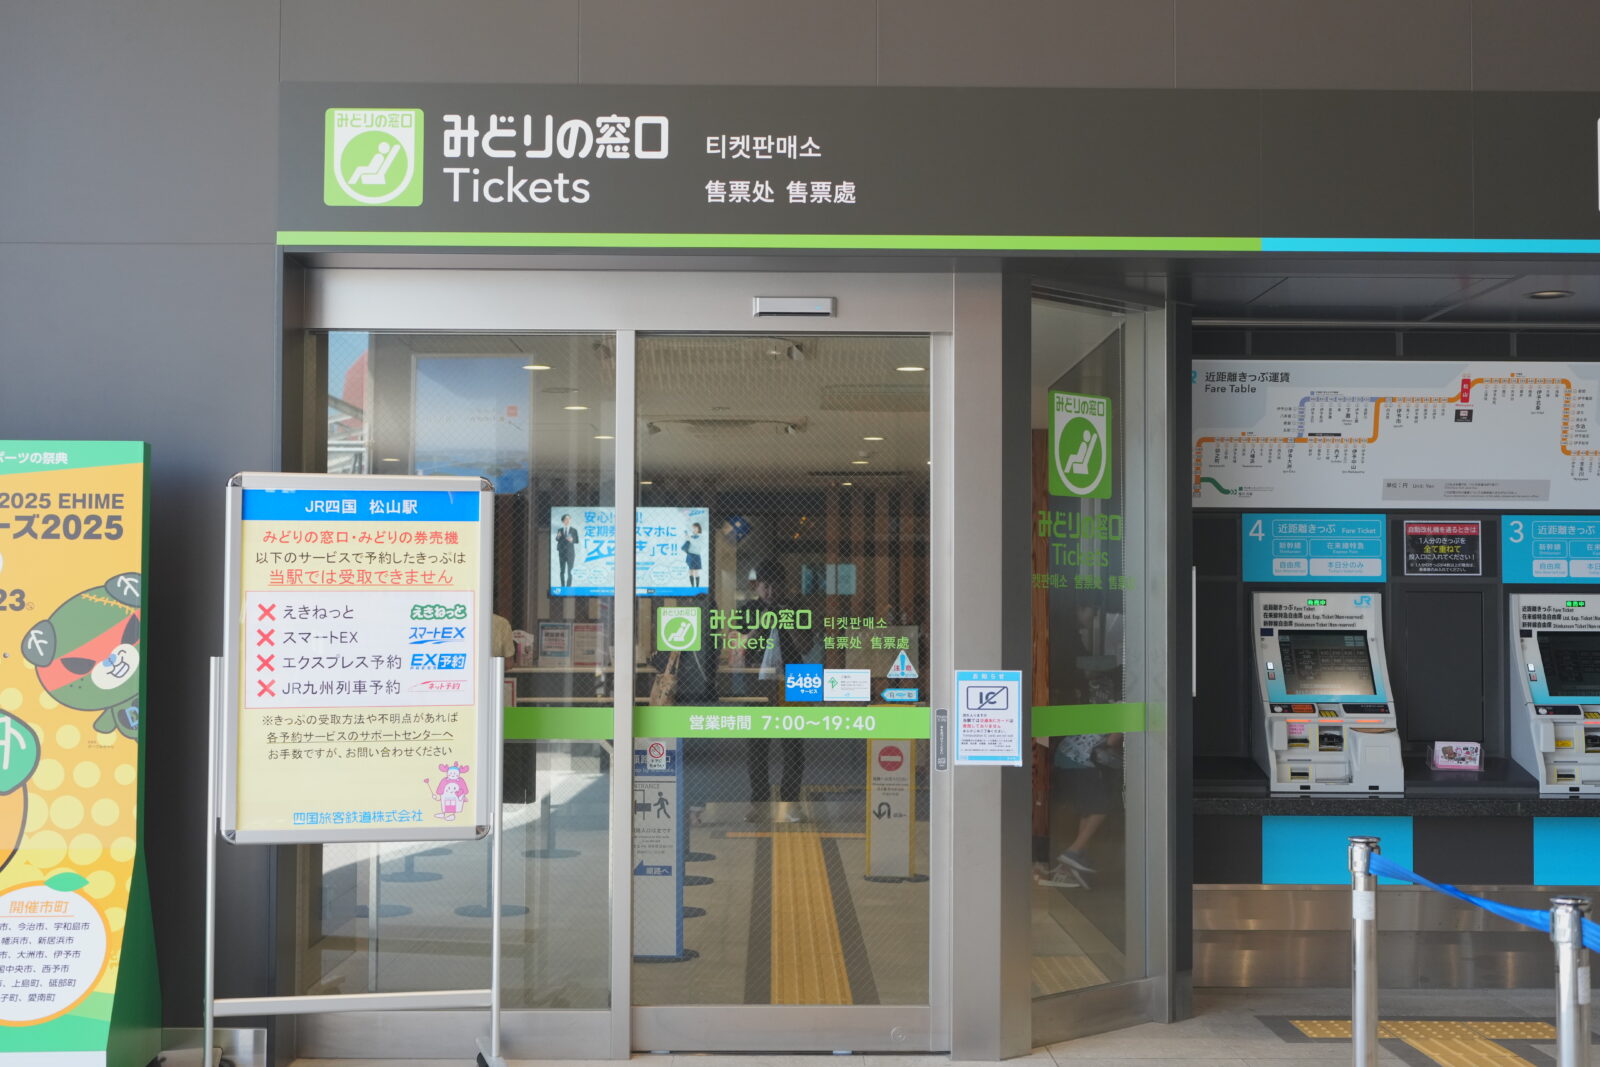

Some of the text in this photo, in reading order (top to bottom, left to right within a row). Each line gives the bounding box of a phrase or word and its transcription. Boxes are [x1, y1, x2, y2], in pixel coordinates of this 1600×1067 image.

[335, 112, 413, 129] みどりの窓口
[443, 114, 669, 159] みどりの窓口
[705, 134, 822, 159] 티켓판매소
[443, 167, 590, 203] Tickets
[705, 180, 856, 204] 售票处 售票處
[1205, 371, 1290, 383] 近距離きっぷ運賃
[1205, 385, 1257, 393] Fare Table
[1056, 395, 1105, 416] みどりの窓口
[0, 493, 124, 509] 2025 EHIME
[305, 499, 418, 514] JR四国 松山駅
[584, 526, 677, 537] 定期券スマホに
[1038, 510, 1122, 541] みどりの窓口
[1249, 520, 1265, 542] 4
[1278, 523, 1336, 534] 近距離きっぷ
[1509, 521, 1524, 543] 3
[1537, 525, 1596, 535] 近距離きっぷ
[263, 530, 459, 545] みどりの窓口・みどりの券売機
[1051, 542, 1109, 567] Tickets
[1423, 545, 1461, 553] 全て重ねて
[255, 551, 466, 565] 以下のサービスで予約したきっぷは
[269, 569, 454, 584] 当駅では受取できません
[1354, 595, 1372, 606] JR
[282, 605, 354, 620] えきねっと
[410, 605, 467, 620] えきねっと
[709, 608, 812, 630] みどりの窓口
[824, 616, 888, 630] 티켓판매소
[282, 631, 358, 644] スマートEX
[408, 627, 466, 640] スマートEX
[710, 633, 775, 649] Tickets
[823, 636, 910, 649] 售票处 售票處
[282, 655, 402, 669] エクスプレス予約
[411, 654, 467, 669] EX予約
[282, 680, 401, 695] JR九州列車予約
[428, 681, 461, 690] ネット予約
[786, 676, 822, 689] 5489
[979, 692, 997, 704] IC
[262, 712, 458, 727] ※きっぷの受取方法や不明点があれば
[689, 715, 751, 731] 営業時間
[267, 730, 454, 743] 各予約サービスのサポートセンターへ
[268, 747, 452, 760] お手数ですが、お問い合わせください
[293, 809, 423, 825] 四国旅客鉄道株式会社
[9, 900, 70, 914] 開催市町
